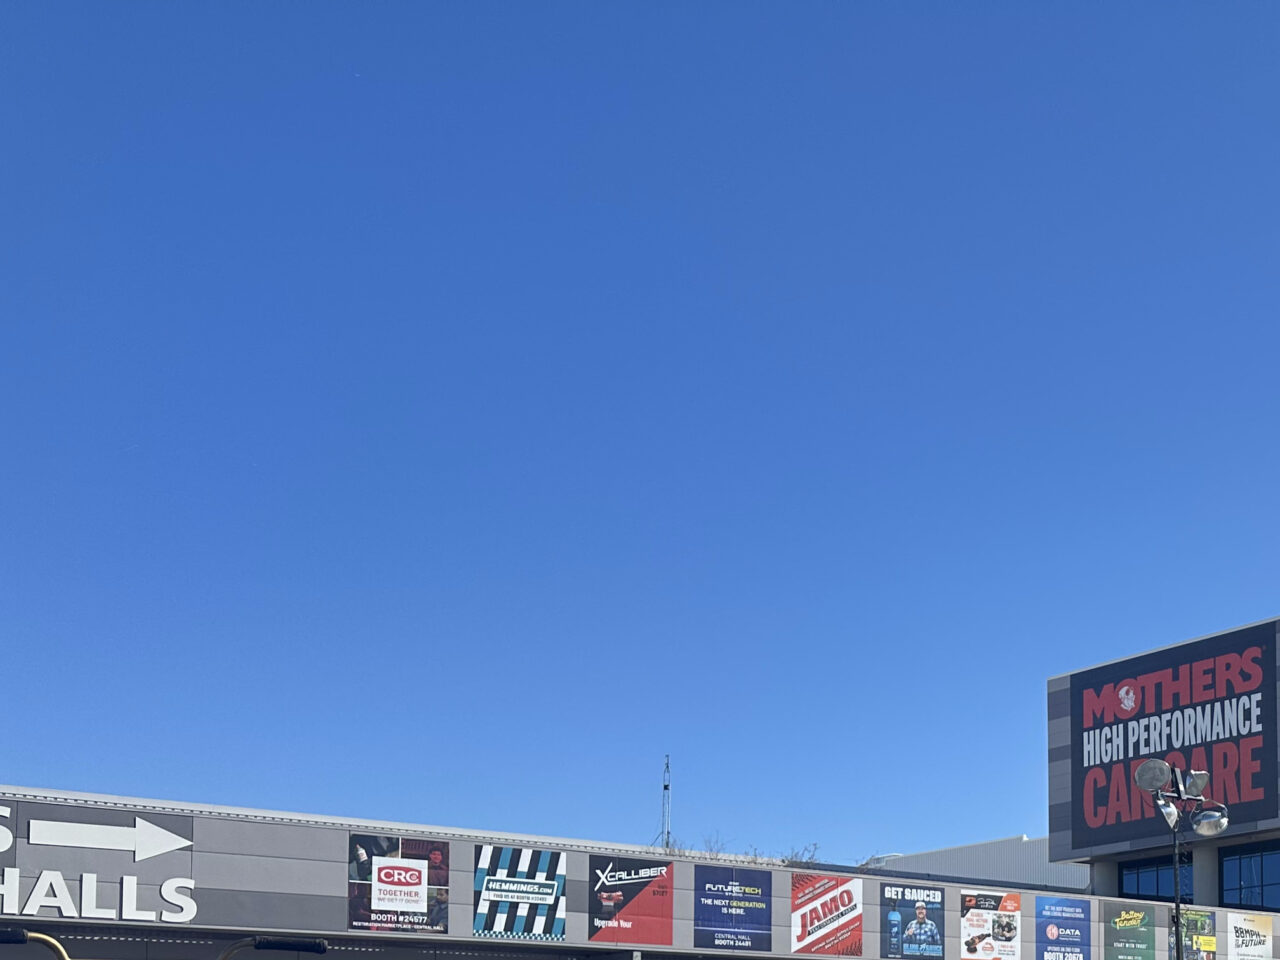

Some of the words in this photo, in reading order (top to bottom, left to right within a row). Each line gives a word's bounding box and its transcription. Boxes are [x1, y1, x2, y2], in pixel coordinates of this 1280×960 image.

[1083, 647, 1263, 728] MOTHERS
[1083, 722, 1124, 767] HIGH
[1128, 693, 1263, 758] PERFORMANCE
[380, 869, 419, 883] CRC
[884, 886, 903, 899] GET
[904, 888, 942, 902] SAUCED
[730, 900, 766, 909] GENERATION
[371, 913, 397, 922] BOOTH
[796, 889, 854, 943] JAMO
[1120, 910, 1145, 919] Battery
[594, 918, 618, 928] Upgrade
[619, 919, 632, 928] Your
[1115, 918, 1141, 930] Tender
[1240, 939, 1266, 948] FUTURE
